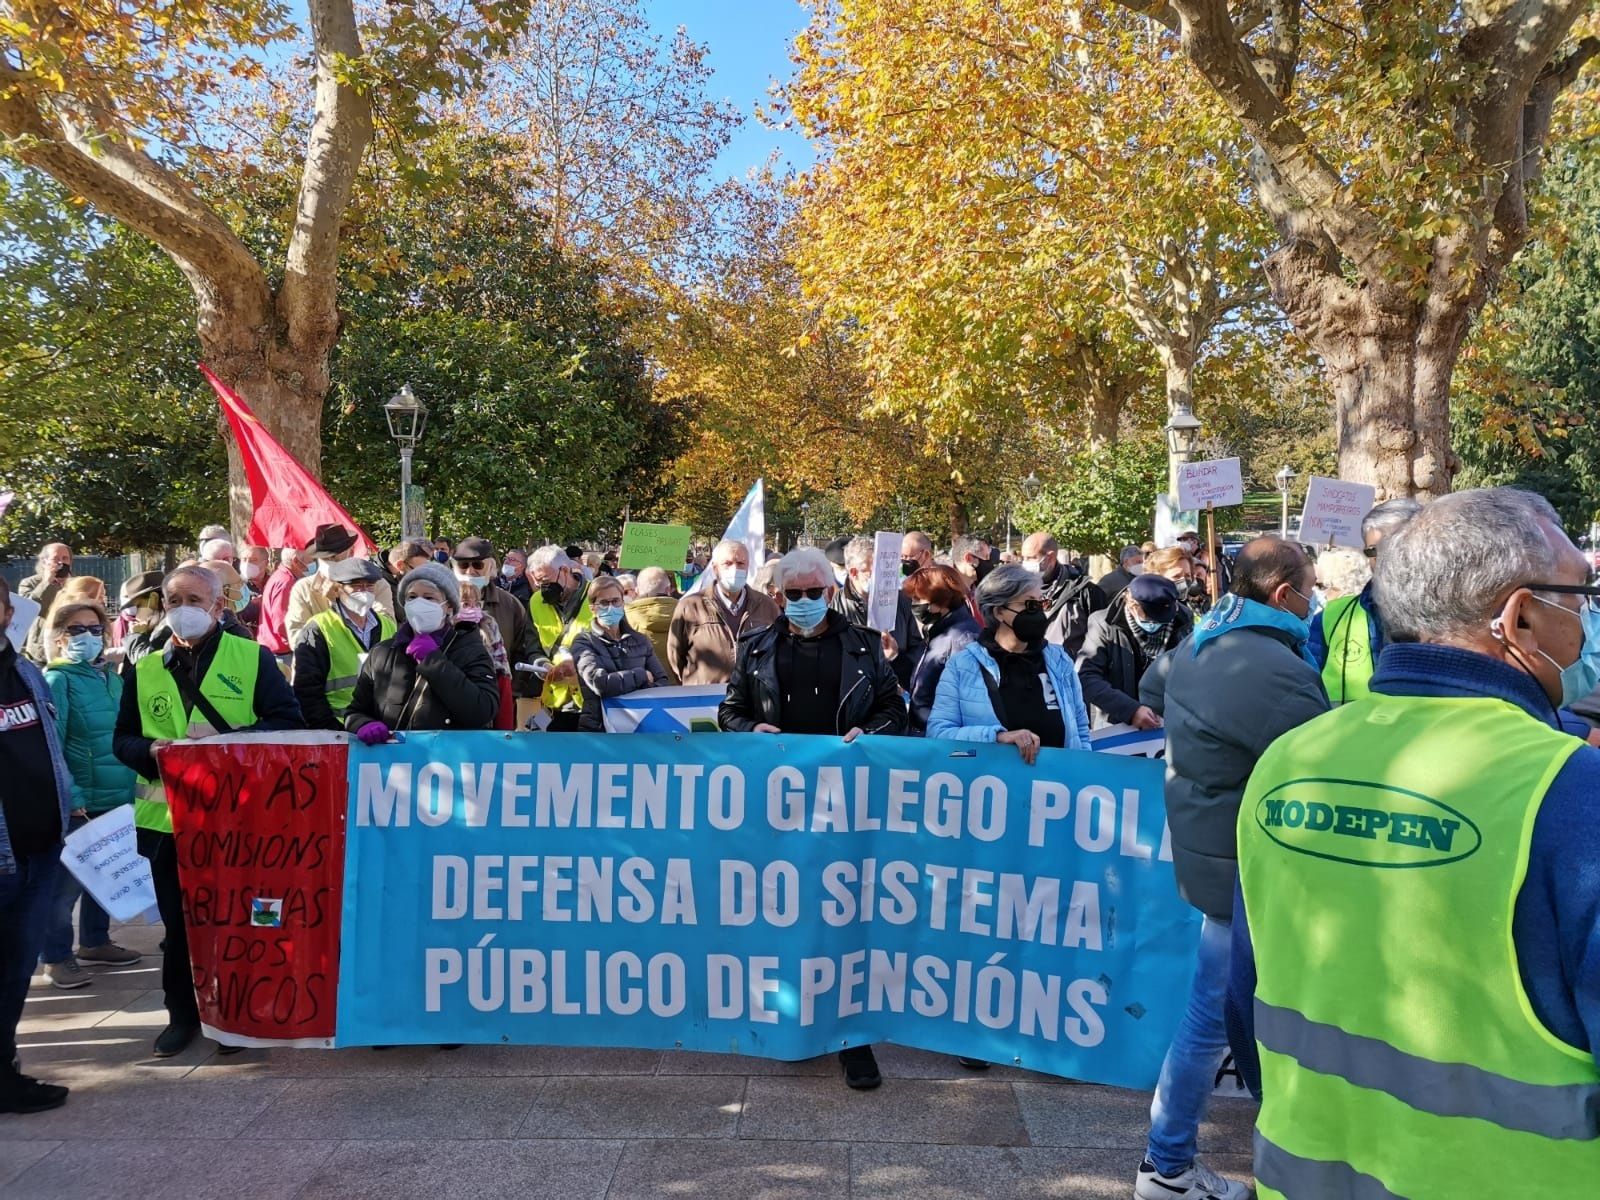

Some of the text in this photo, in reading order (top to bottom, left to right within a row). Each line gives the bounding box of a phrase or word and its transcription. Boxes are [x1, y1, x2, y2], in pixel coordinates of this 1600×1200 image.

[630, 527, 658, 538] CLASES
[173, 769, 247, 814] NON
[356, 761, 746, 832] MOVEMENTO
[766, 765, 1008, 843] GALEGO
[1264, 799, 1461, 853] MODEPEN
[432, 854, 1103, 952] DEFENSA DO SISTEMA
[222, 935, 291, 967] DOS
[424, 933, 1109, 1048] PÚBLICO DE PENSIÓNS
